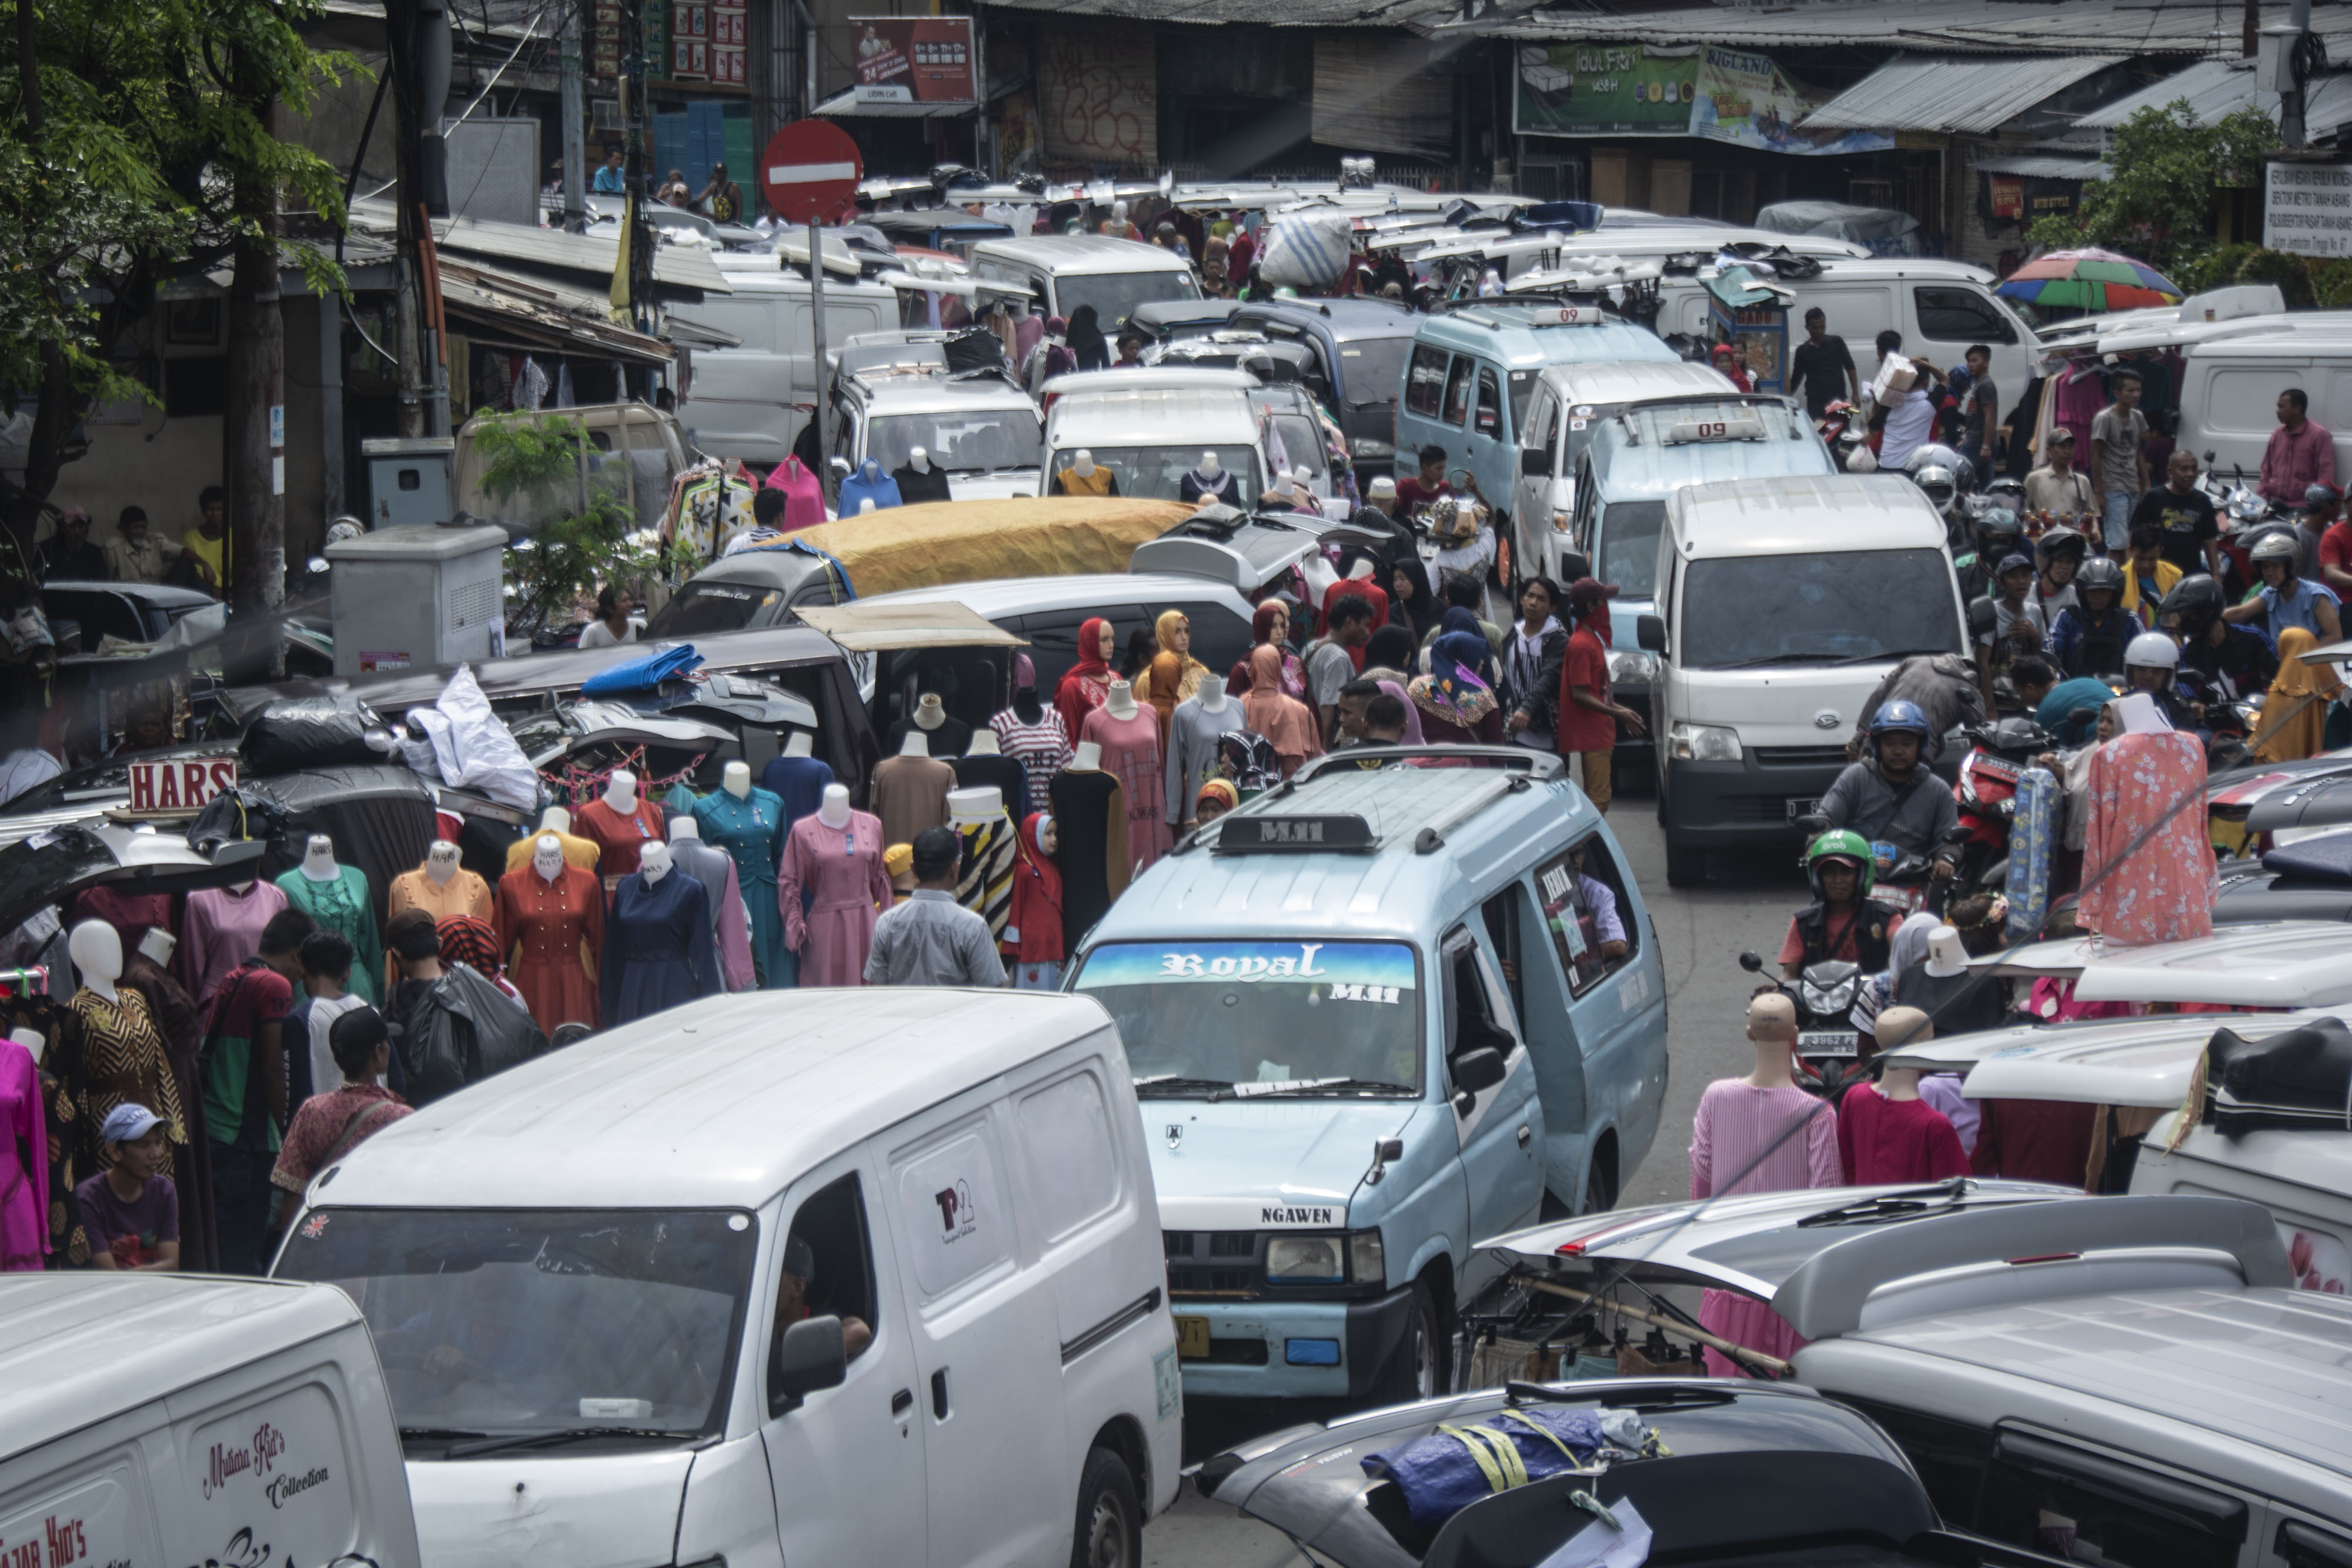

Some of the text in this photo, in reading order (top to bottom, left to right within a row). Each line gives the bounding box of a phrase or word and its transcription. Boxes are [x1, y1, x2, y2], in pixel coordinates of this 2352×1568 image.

[864, 68, 876, 82] 24
[1611, 79, 1618, 91] H
[2272, 191, 2350, 208] SEKTOR METRO TANAH ABANG
[1560, 309, 1578, 323] 09
[1736, 312, 1772, 325] GADO
[1697, 422, 1725, 437] 09
[1988, 760, 2010, 771] 3555
[130, 764, 235, 811] HARS
[1787, 802, 1796, 817] D
[1259, 822, 1324, 842] M.11
[312, 845, 331, 857] HARS
[1822, 842, 1847, 851] Grab
[432, 851, 456, 864] HARS
[540, 851, 560, 860] HARS
[1157, 942, 1326, 984] Royal
[1328, 983, 1400, 1005] M.11
[1798, 1037, 1805, 1045] B
[1812, 1036, 1840, 1045] 3962
[1261, 1208, 1332, 1224] NGAWEN
[203, 1422, 286, 1501] Mutiara Kid's
[265, 1467, 329, 1510] Collection
[0, 1514, 87, 1568] AJAR KID'S
